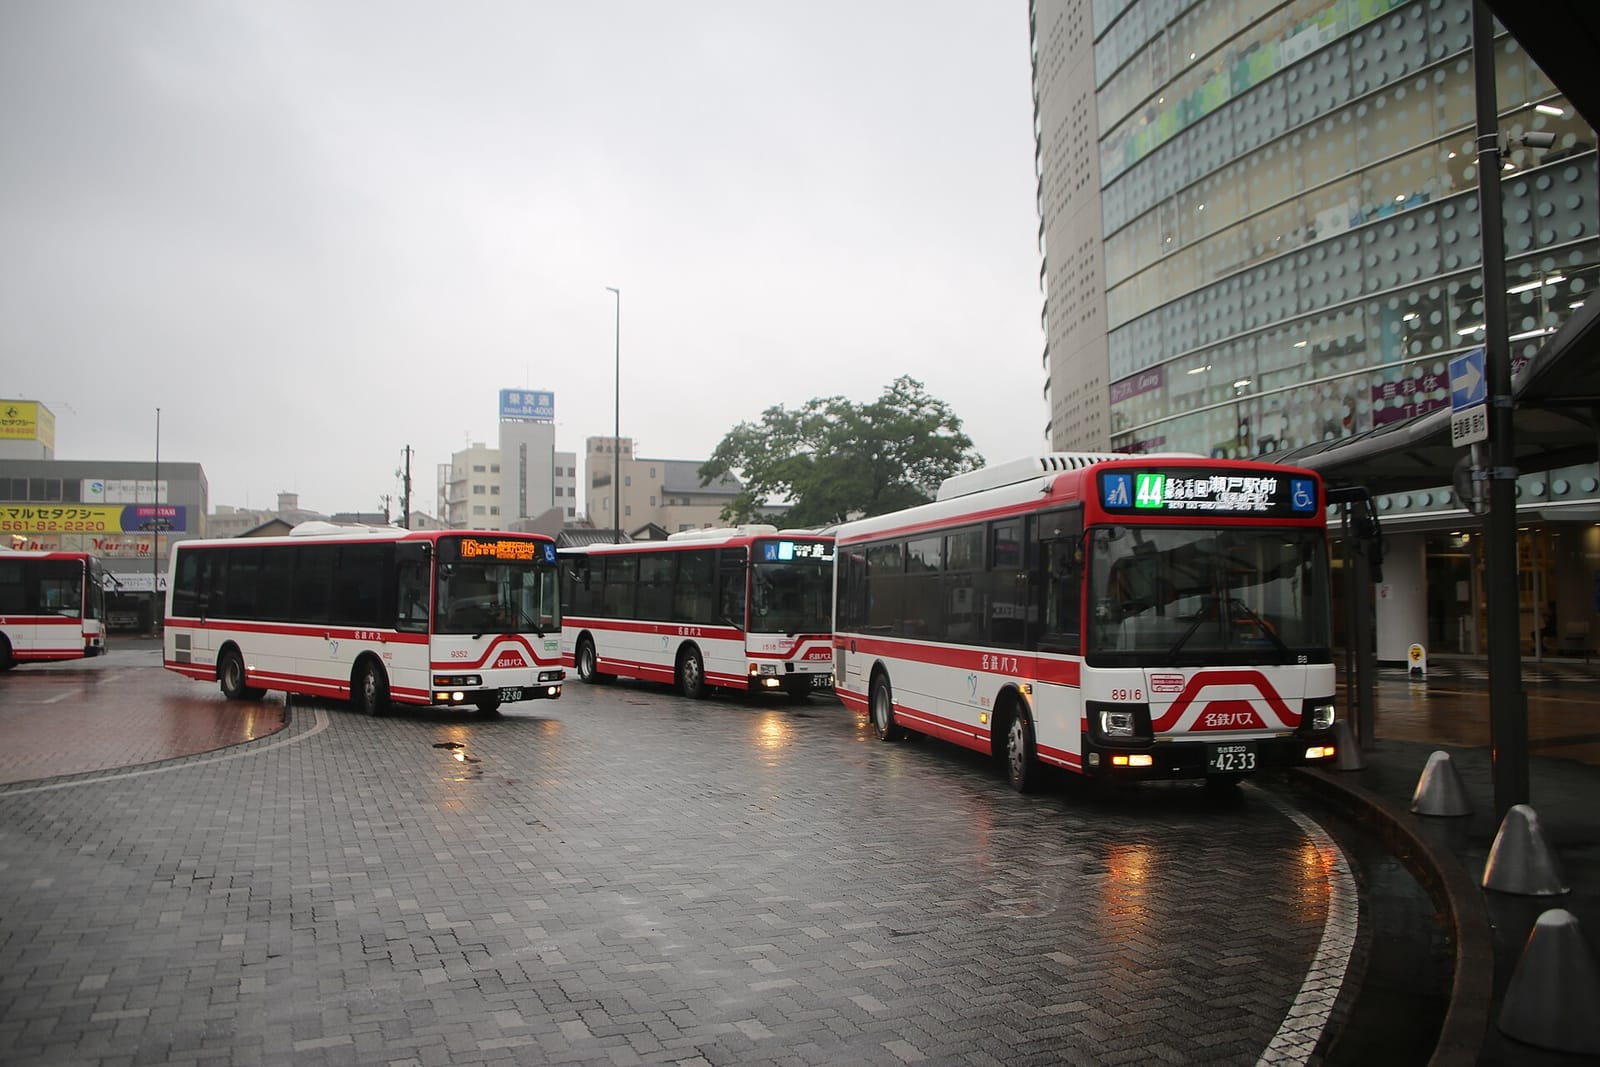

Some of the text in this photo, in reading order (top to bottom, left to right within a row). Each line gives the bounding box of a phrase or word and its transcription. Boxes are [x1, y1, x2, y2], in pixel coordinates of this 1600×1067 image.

[1137, 477, 1162, 504] 44
[1209, 476, 1277, 494] 瀬戸駅前
[7, 508, 105, 519] マルセタクシー
[462, 540, 476, 557] 16
[451, 650, 468, 658] 9352
[982, 654, 1018, 673] 名鉄バス
[1111, 689, 1142, 700] 8916
[1205, 713, 1254, 726] 名鉄バス
[1216, 753, 1256, 771] 42-33
